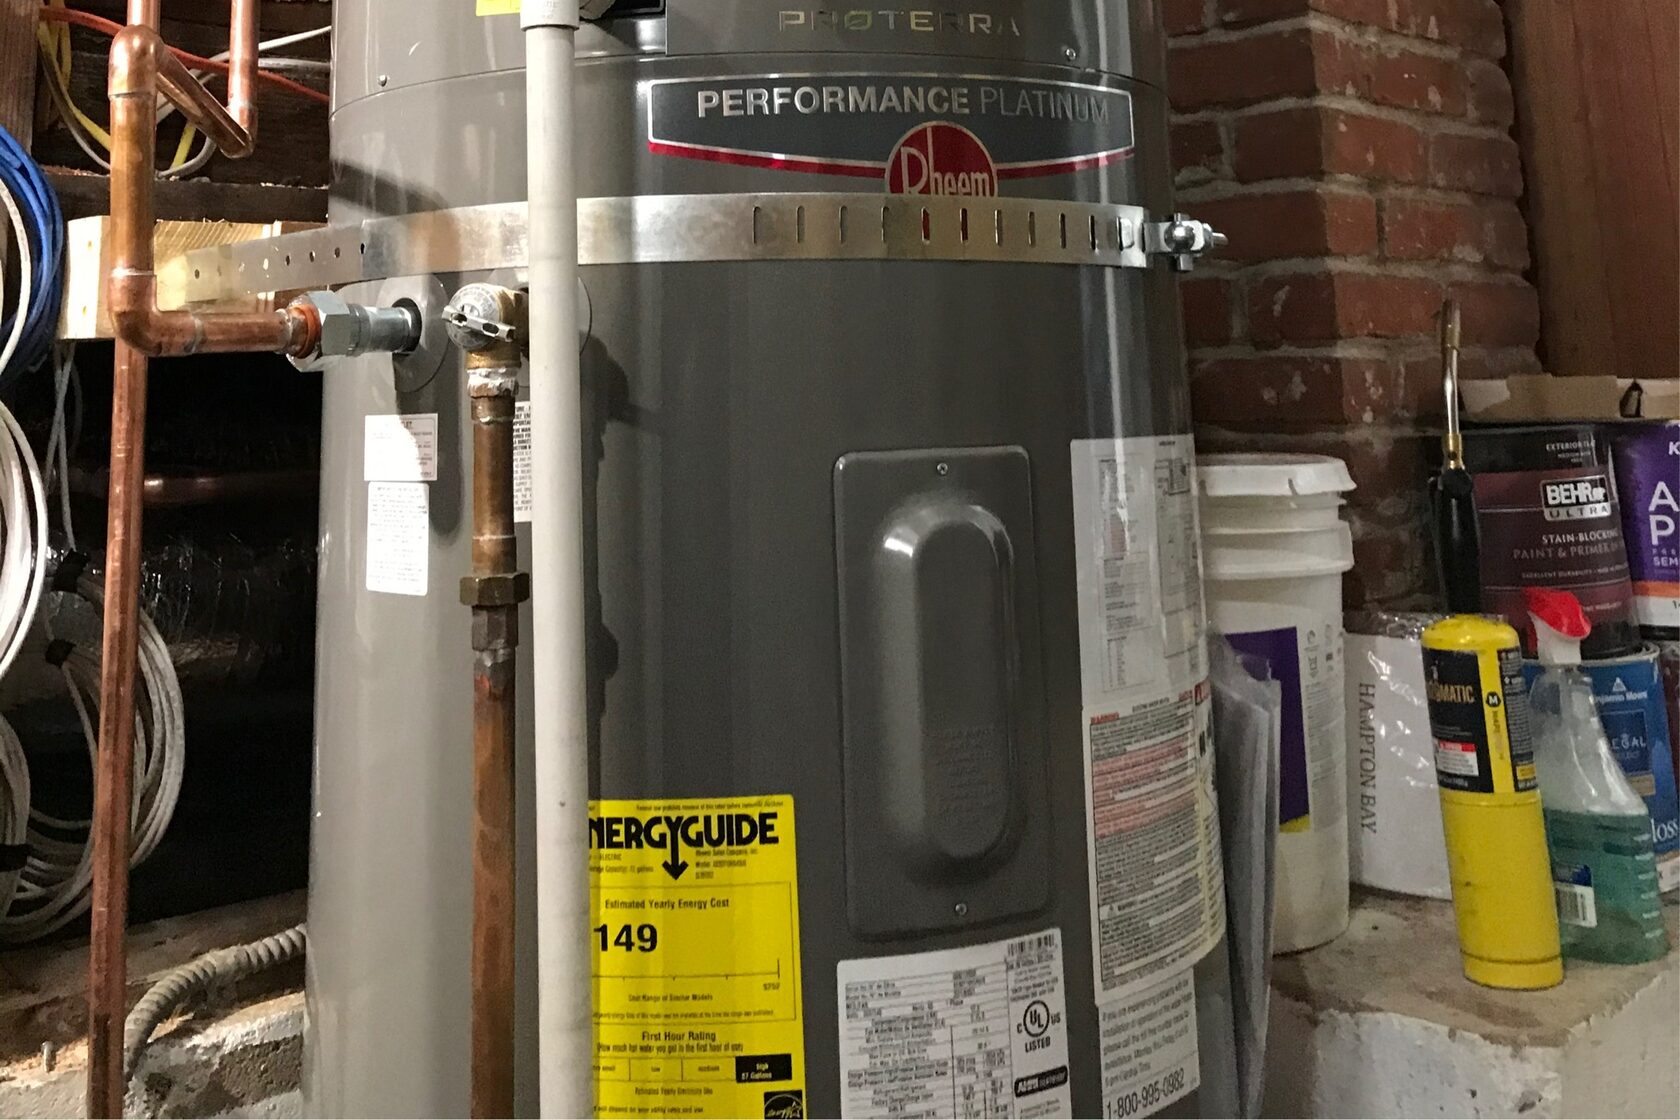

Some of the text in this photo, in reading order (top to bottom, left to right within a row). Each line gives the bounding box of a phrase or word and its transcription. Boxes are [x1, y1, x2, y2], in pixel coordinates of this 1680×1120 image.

[697, 86, 1111, 124] PERFORMANCE PLATINUM
[900, 126, 993, 198] Rheem
[1546, 442, 1583, 451] EXTERIOR
[1546, 481, 1592, 505] BEHR
[1549, 506, 1608, 518] ULTRA
[1542, 528, 1619, 545] STAIN-BLOCKING
[1513, 547, 1554, 560] PAINT
[1558, 547, 1567, 558] &
[1612, 737, 1646, 749] EGAL
[1359, 683, 1377, 834] HAMPTON BAY
[589, 812, 780, 849] NERGYGUIDE
[605, 897, 730, 911] Estimated Yearly Energy Cost
[1029, 1009, 1045, 1029] UL
[1050, 1011, 1061, 1025] US
[642, 1030, 717, 1042] First Hour Rating
[1024, 1036, 1051, 1053] LISTED
[1106, 1067, 1185, 1119] 1-800-995-0982
